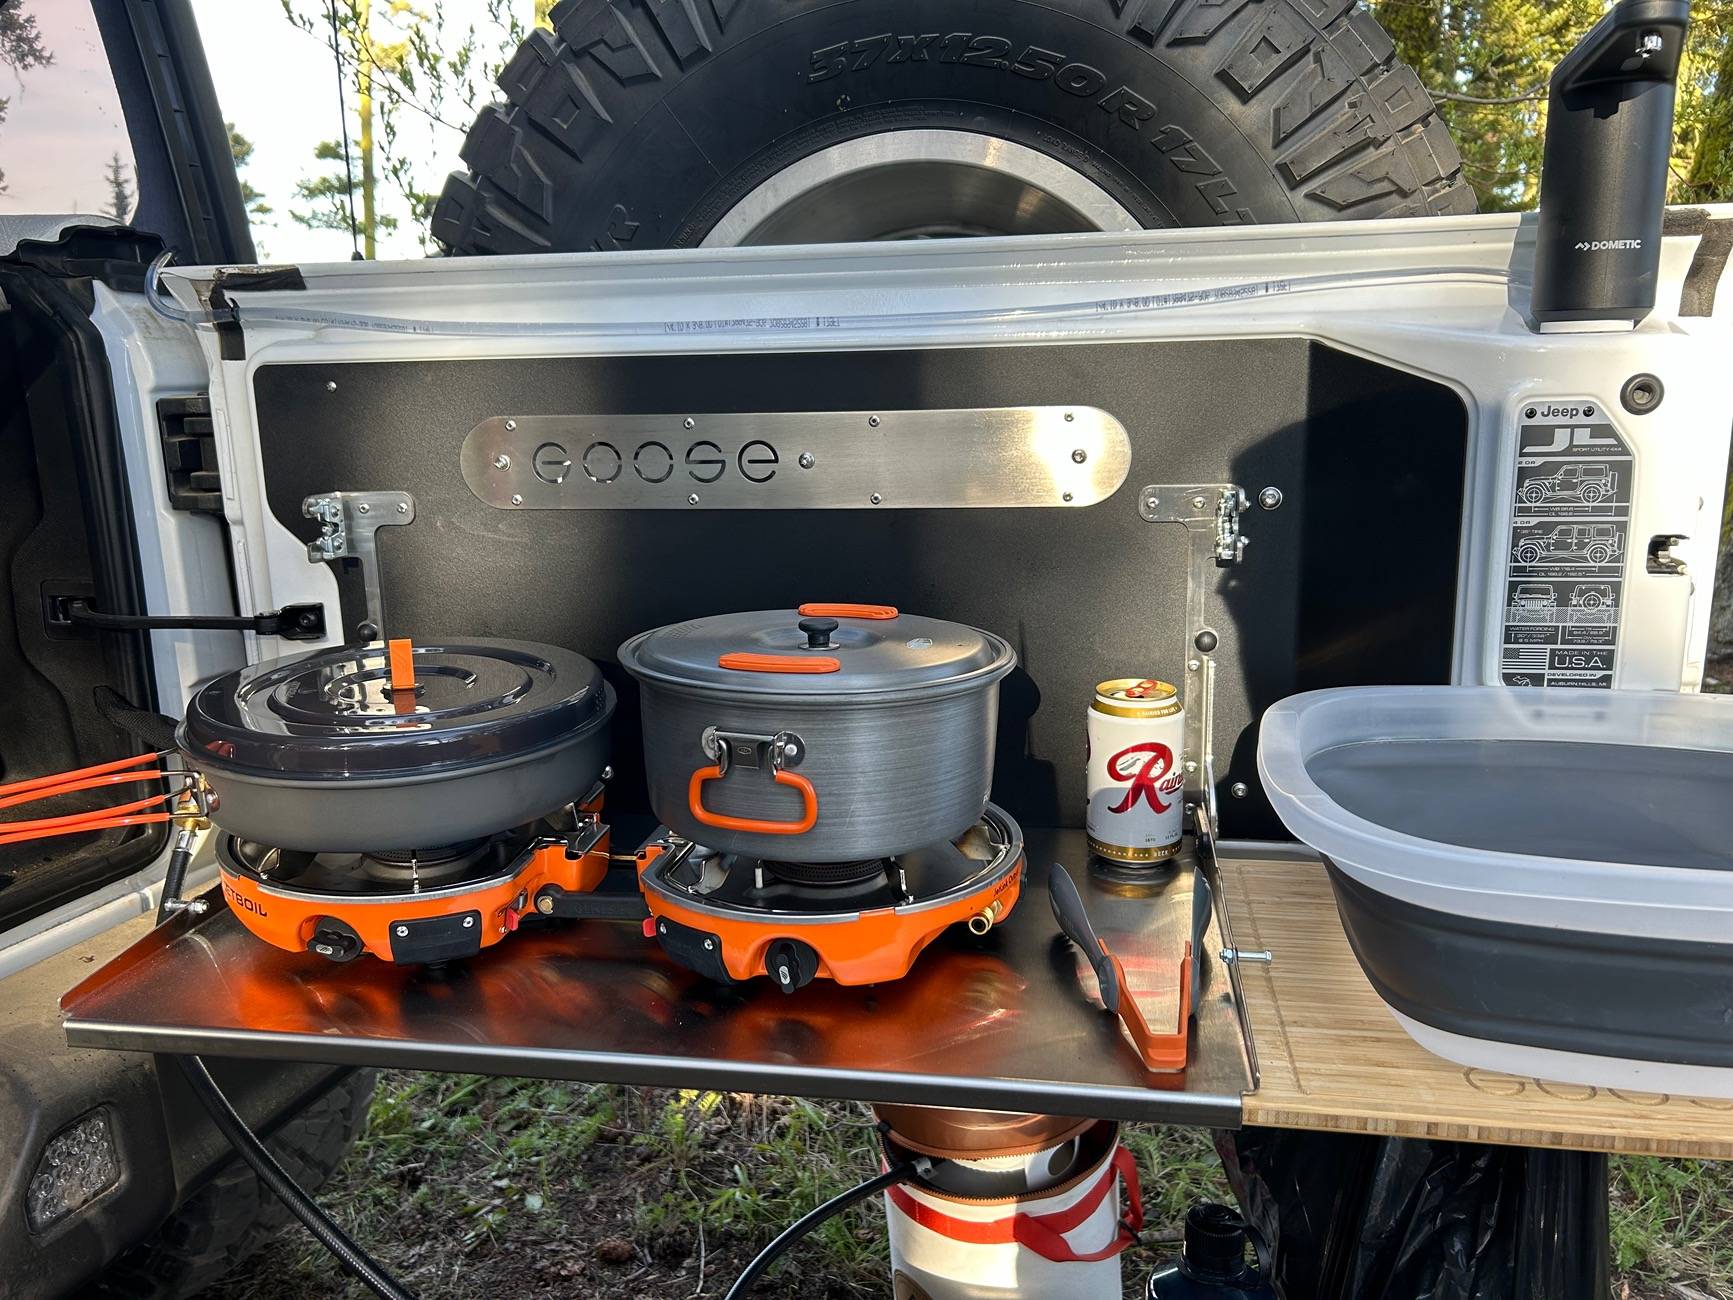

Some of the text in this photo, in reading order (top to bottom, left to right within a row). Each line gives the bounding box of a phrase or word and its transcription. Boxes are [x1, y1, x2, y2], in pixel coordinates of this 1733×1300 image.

[1591, 239, 1641, 251] DOMETIC
[1541, 405, 1579, 419] Jeep
[1522, 428, 1618, 453] JL
[1555, 656, 1607, 668] U.S.A.
